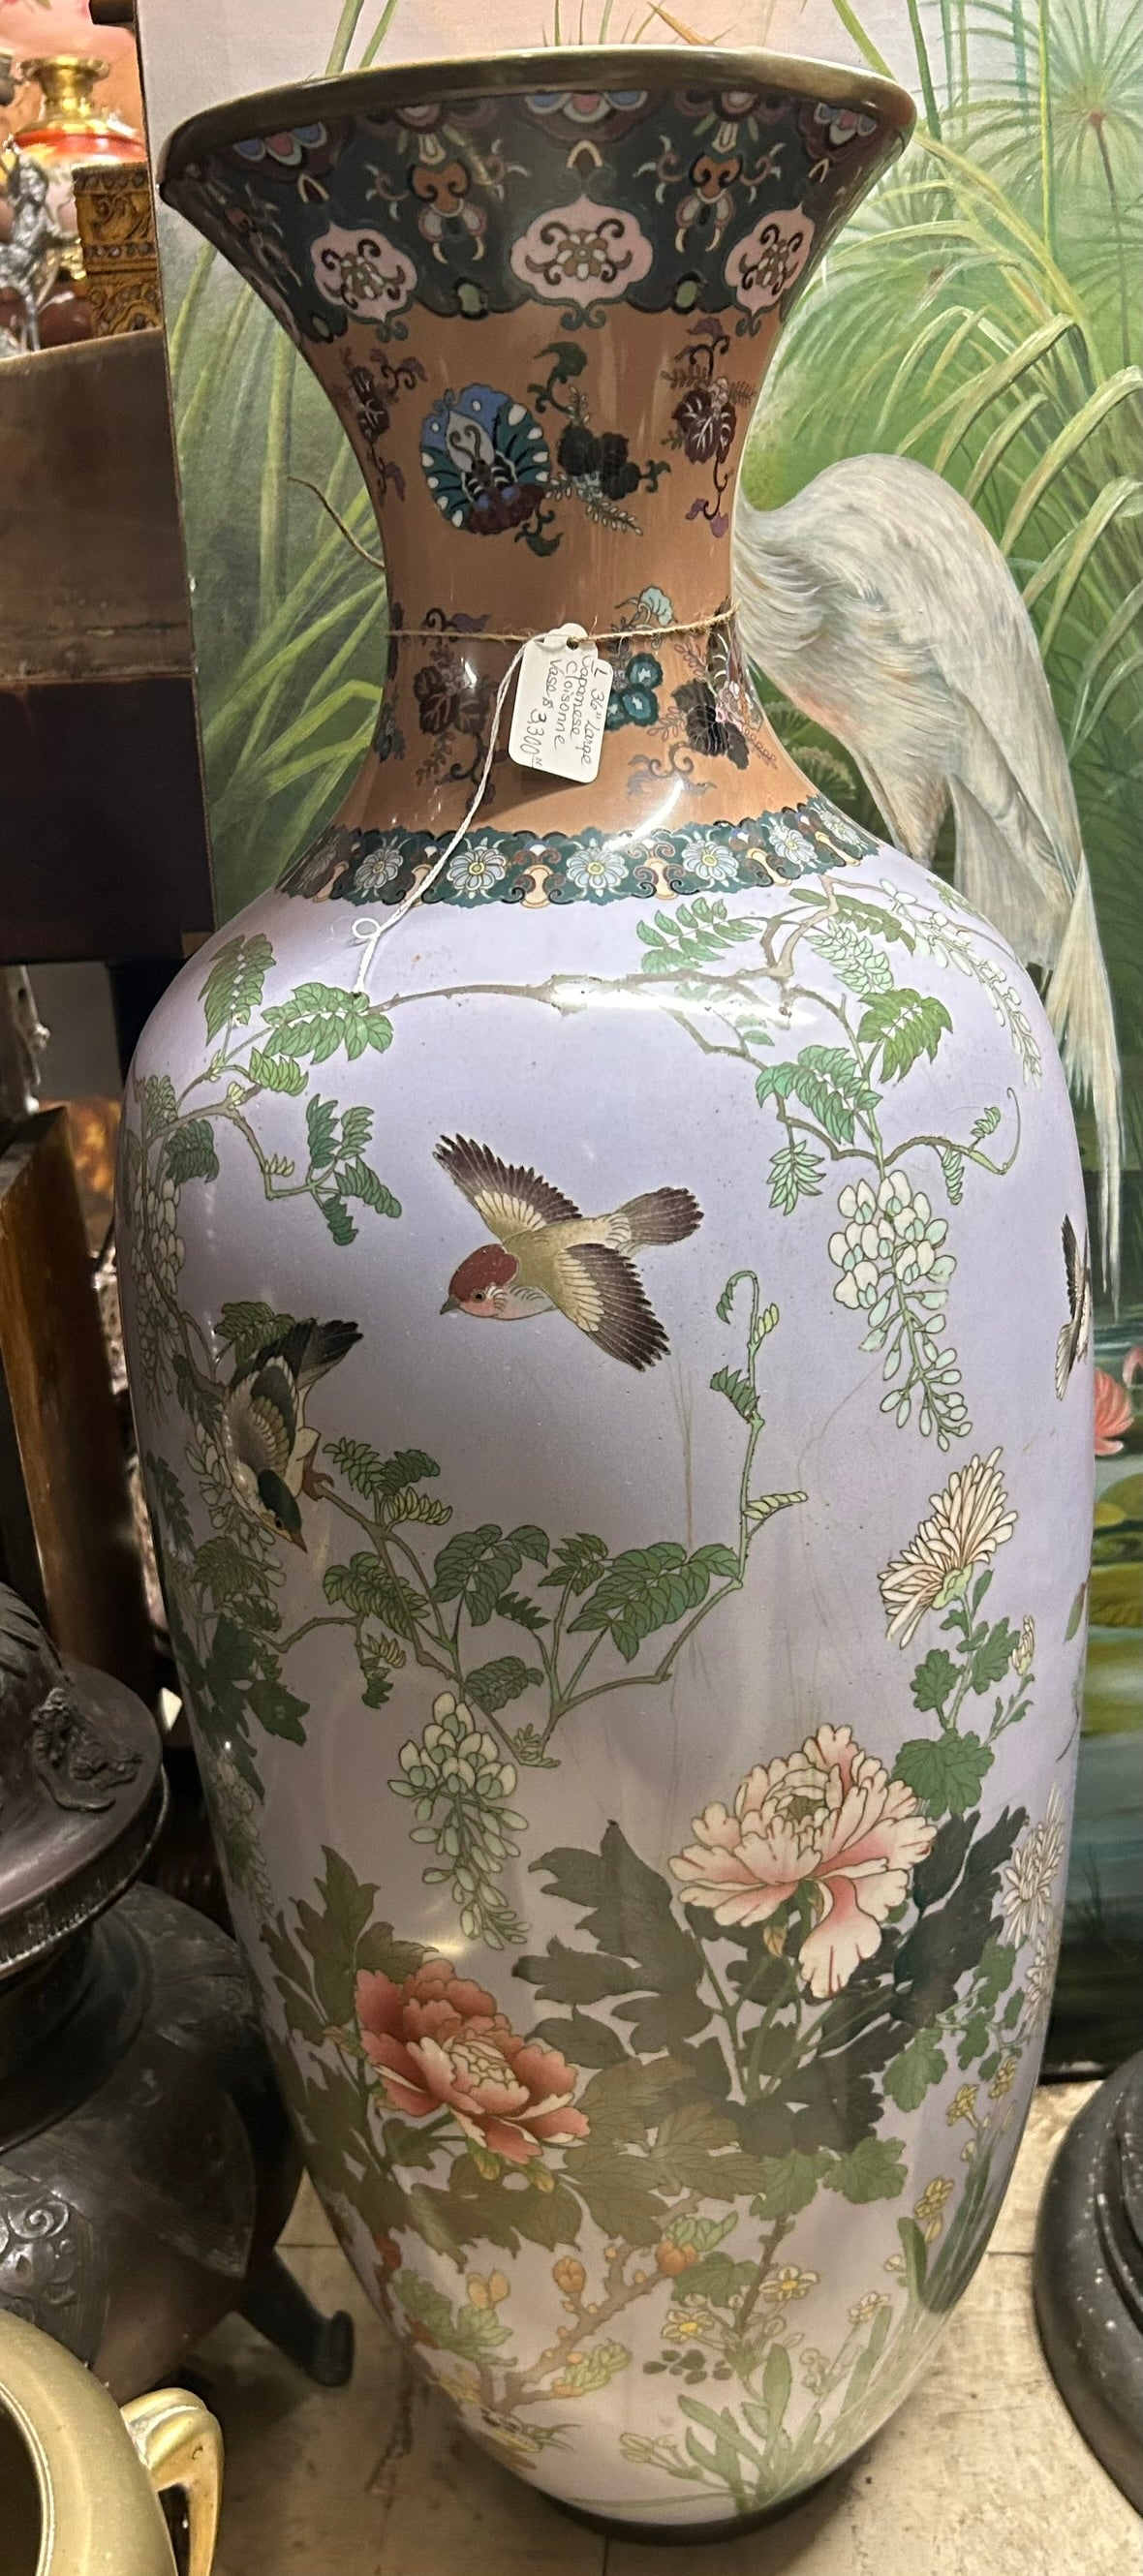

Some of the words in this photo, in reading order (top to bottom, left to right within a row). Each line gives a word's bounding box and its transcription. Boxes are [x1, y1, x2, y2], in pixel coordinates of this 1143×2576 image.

[554, 660, 578, 751] Cloisonne
[570, 655, 594, 741] Japanese
[575, 720, 601, 765] Large
